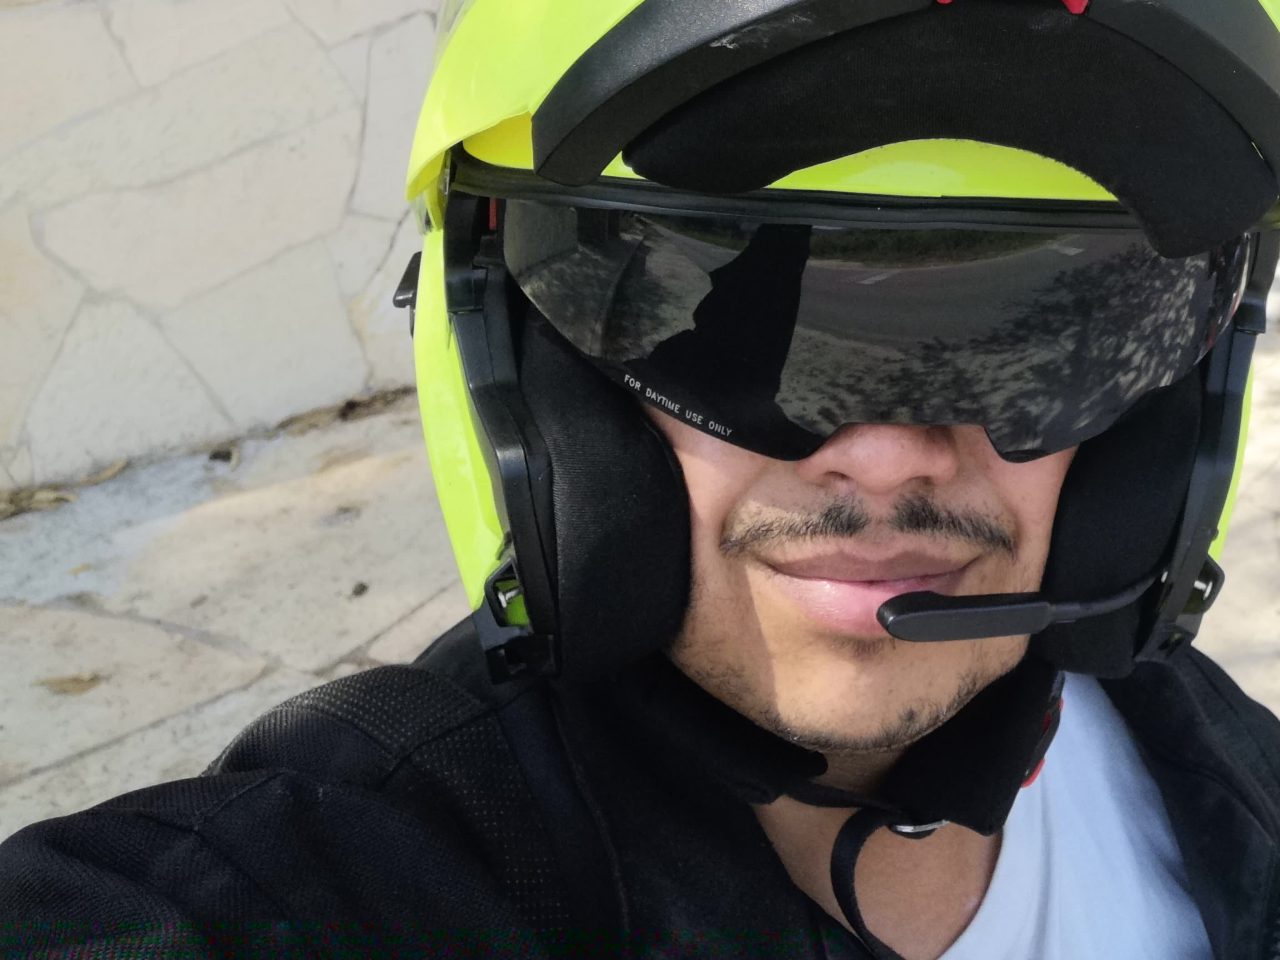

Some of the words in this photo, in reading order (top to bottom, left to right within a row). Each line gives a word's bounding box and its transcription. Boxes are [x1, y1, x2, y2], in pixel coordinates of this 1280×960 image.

[623, 374, 641, 391] FOR
[645, 388, 680, 414] DAYTIME
[685, 410, 704, 425] USE
[708, 421, 733, 437] ONLY
